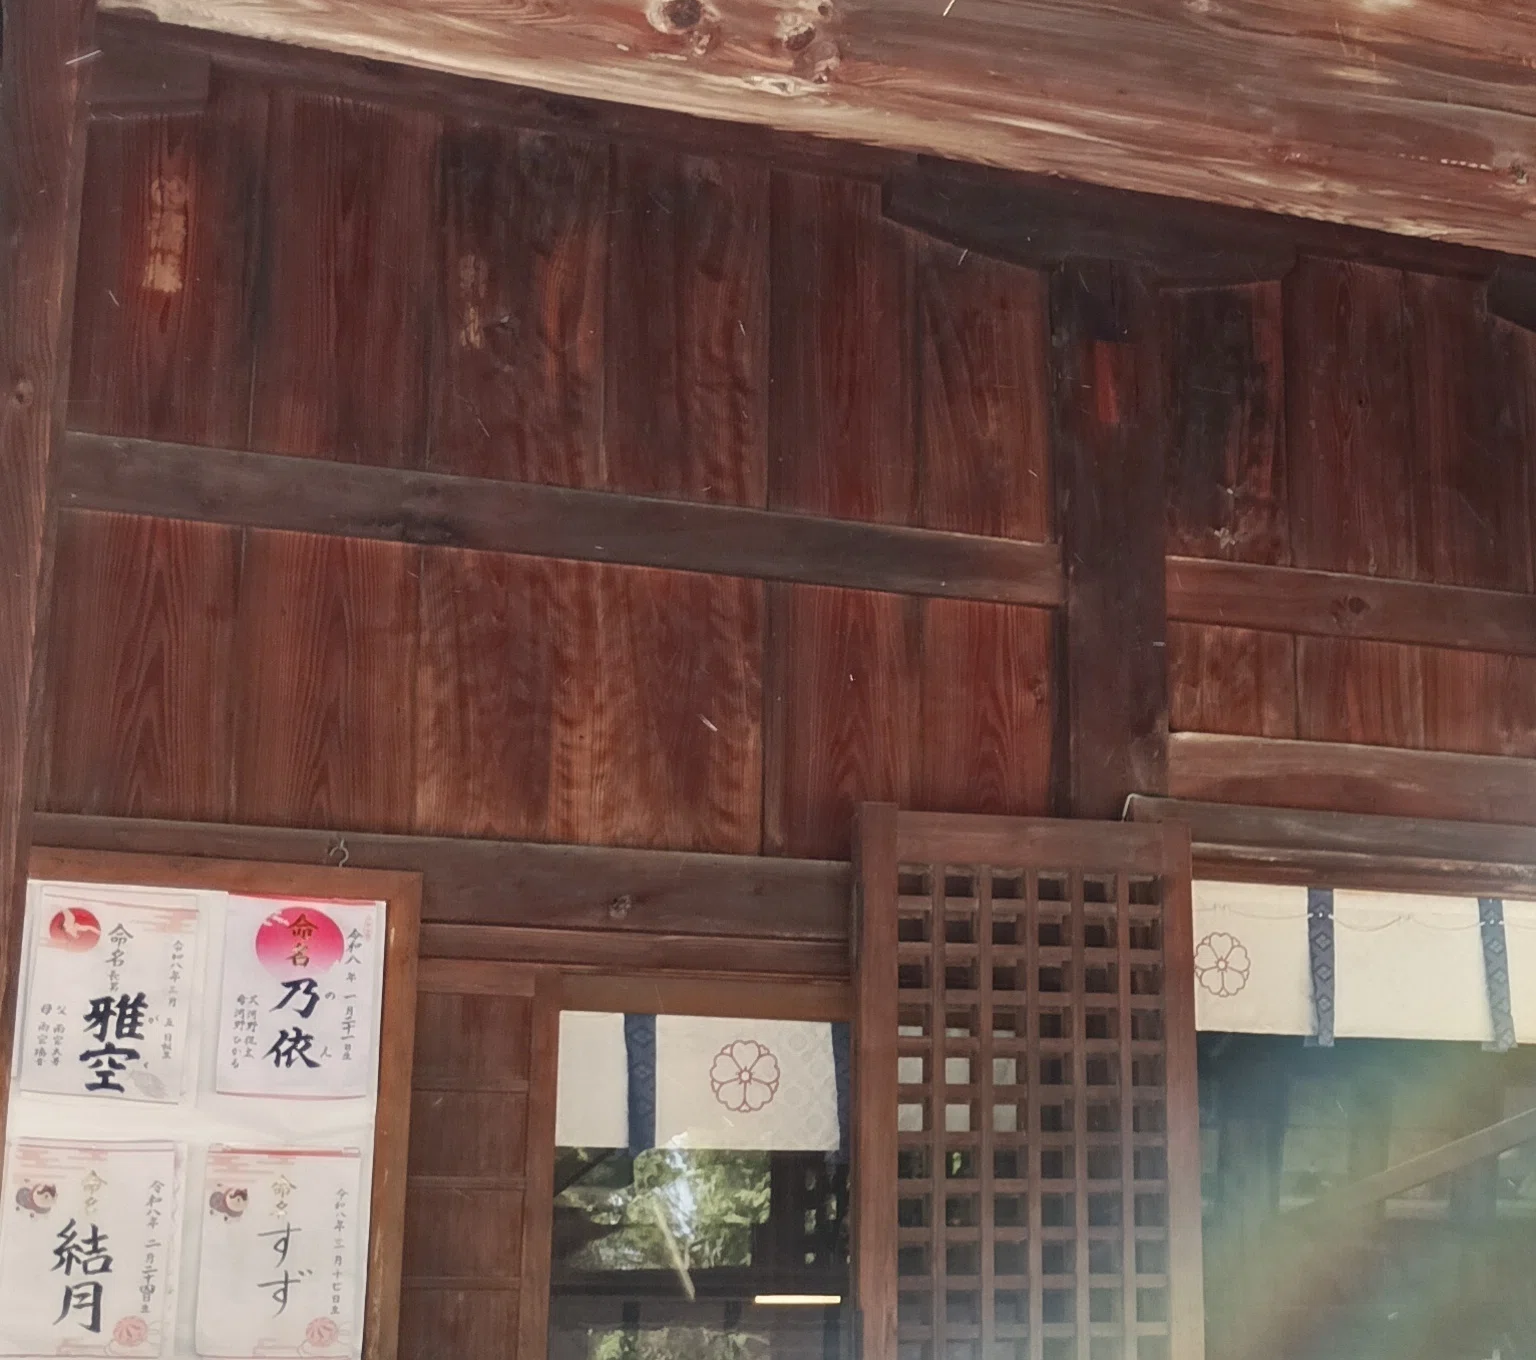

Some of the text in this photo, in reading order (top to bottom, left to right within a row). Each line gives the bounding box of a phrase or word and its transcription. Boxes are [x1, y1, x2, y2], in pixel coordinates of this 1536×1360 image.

[105, 923, 134, 968] 命名
[286, 912, 319, 968] 命名
[79, 991, 149, 1093] 雅空
[261, 976, 321, 1069] 乃依
[50, 1218, 114, 1333] 結月
[257, 1221, 313, 1318] すず
